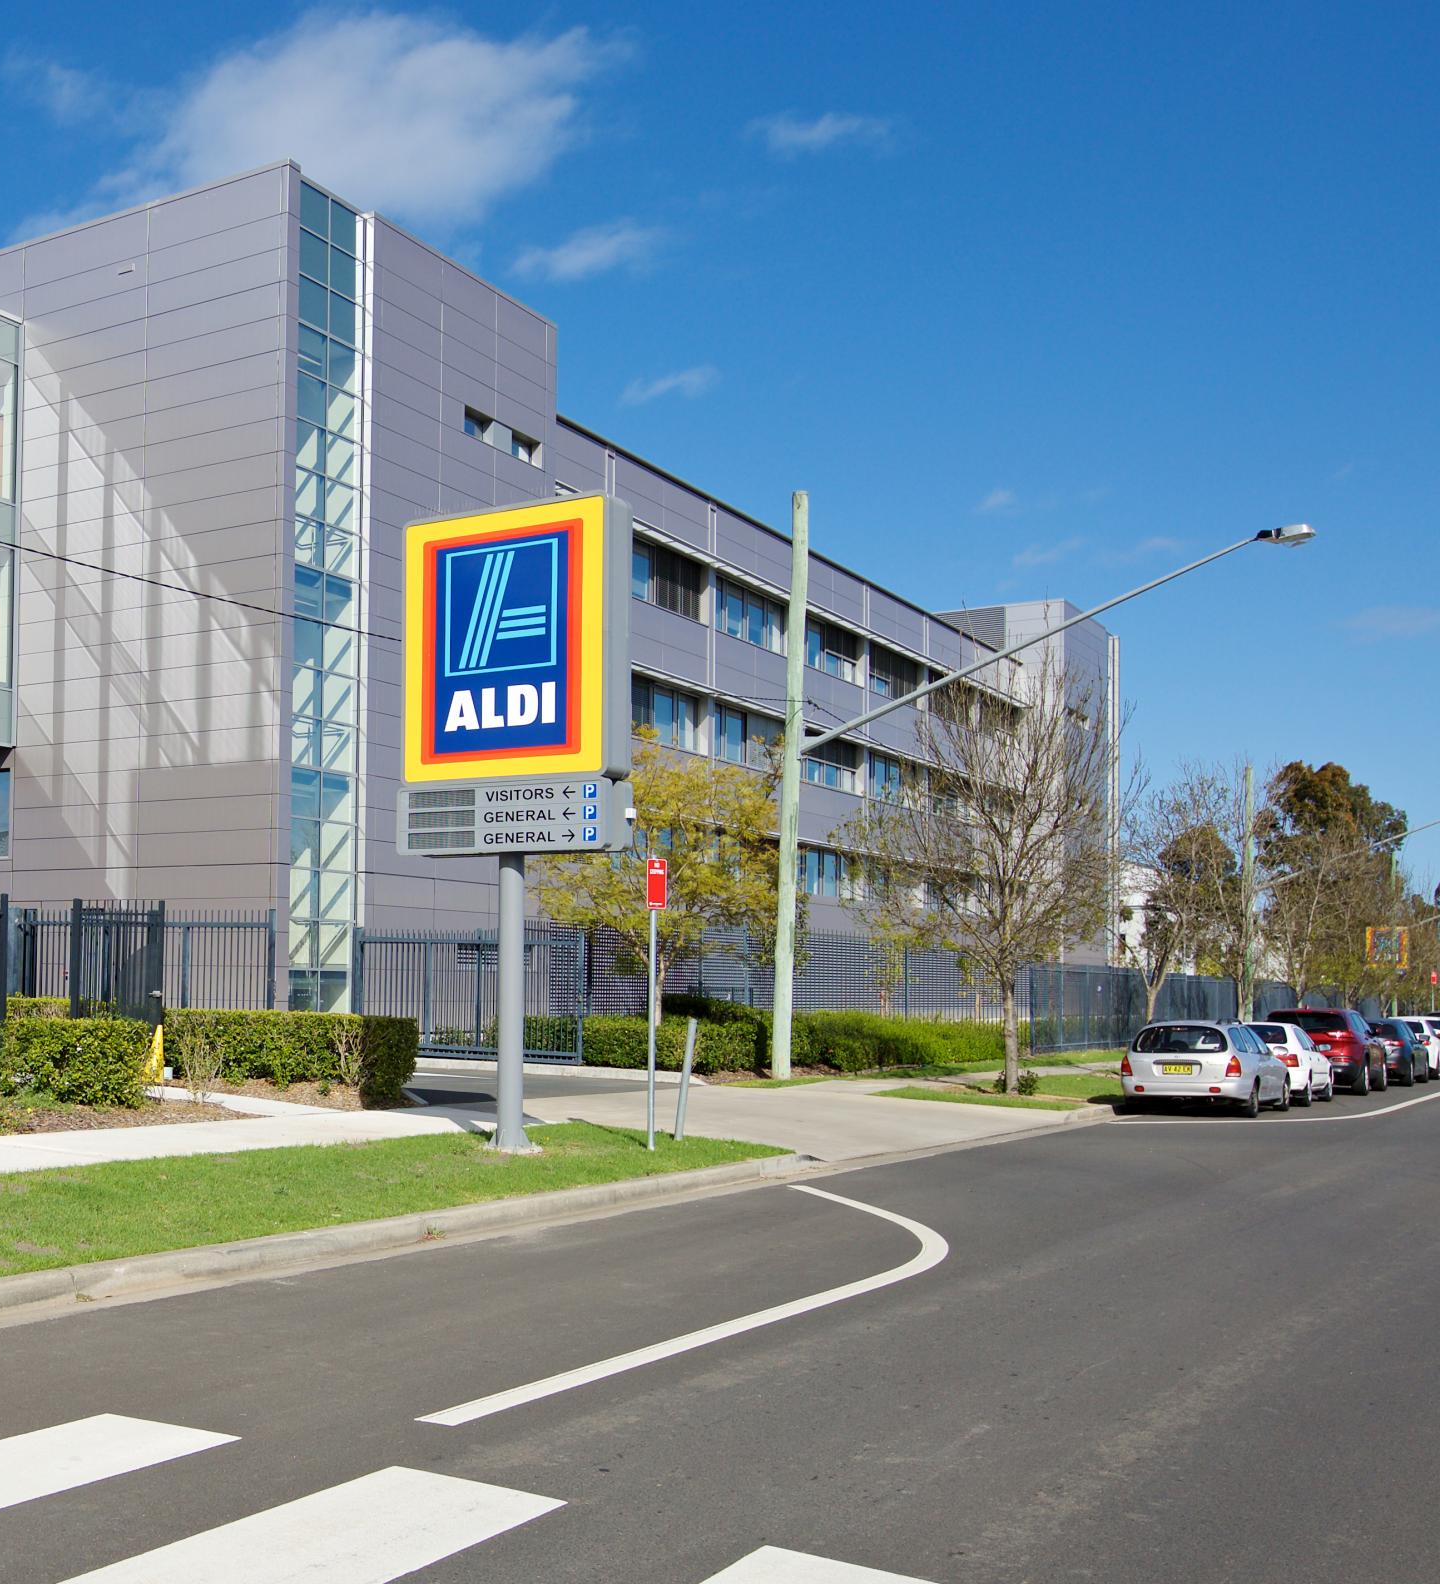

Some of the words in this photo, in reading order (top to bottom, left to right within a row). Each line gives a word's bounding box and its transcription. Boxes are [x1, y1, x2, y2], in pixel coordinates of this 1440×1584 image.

[444, 681, 556, 732] ALDI
[485, 787, 554, 802] VISITORS
[585, 784, 595, 798] P
[483, 809, 556, 823] GENERAL
[585, 806, 595, 819] P
[483, 831, 556, 844] GENERAL
[585, 827, 595, 841] P
